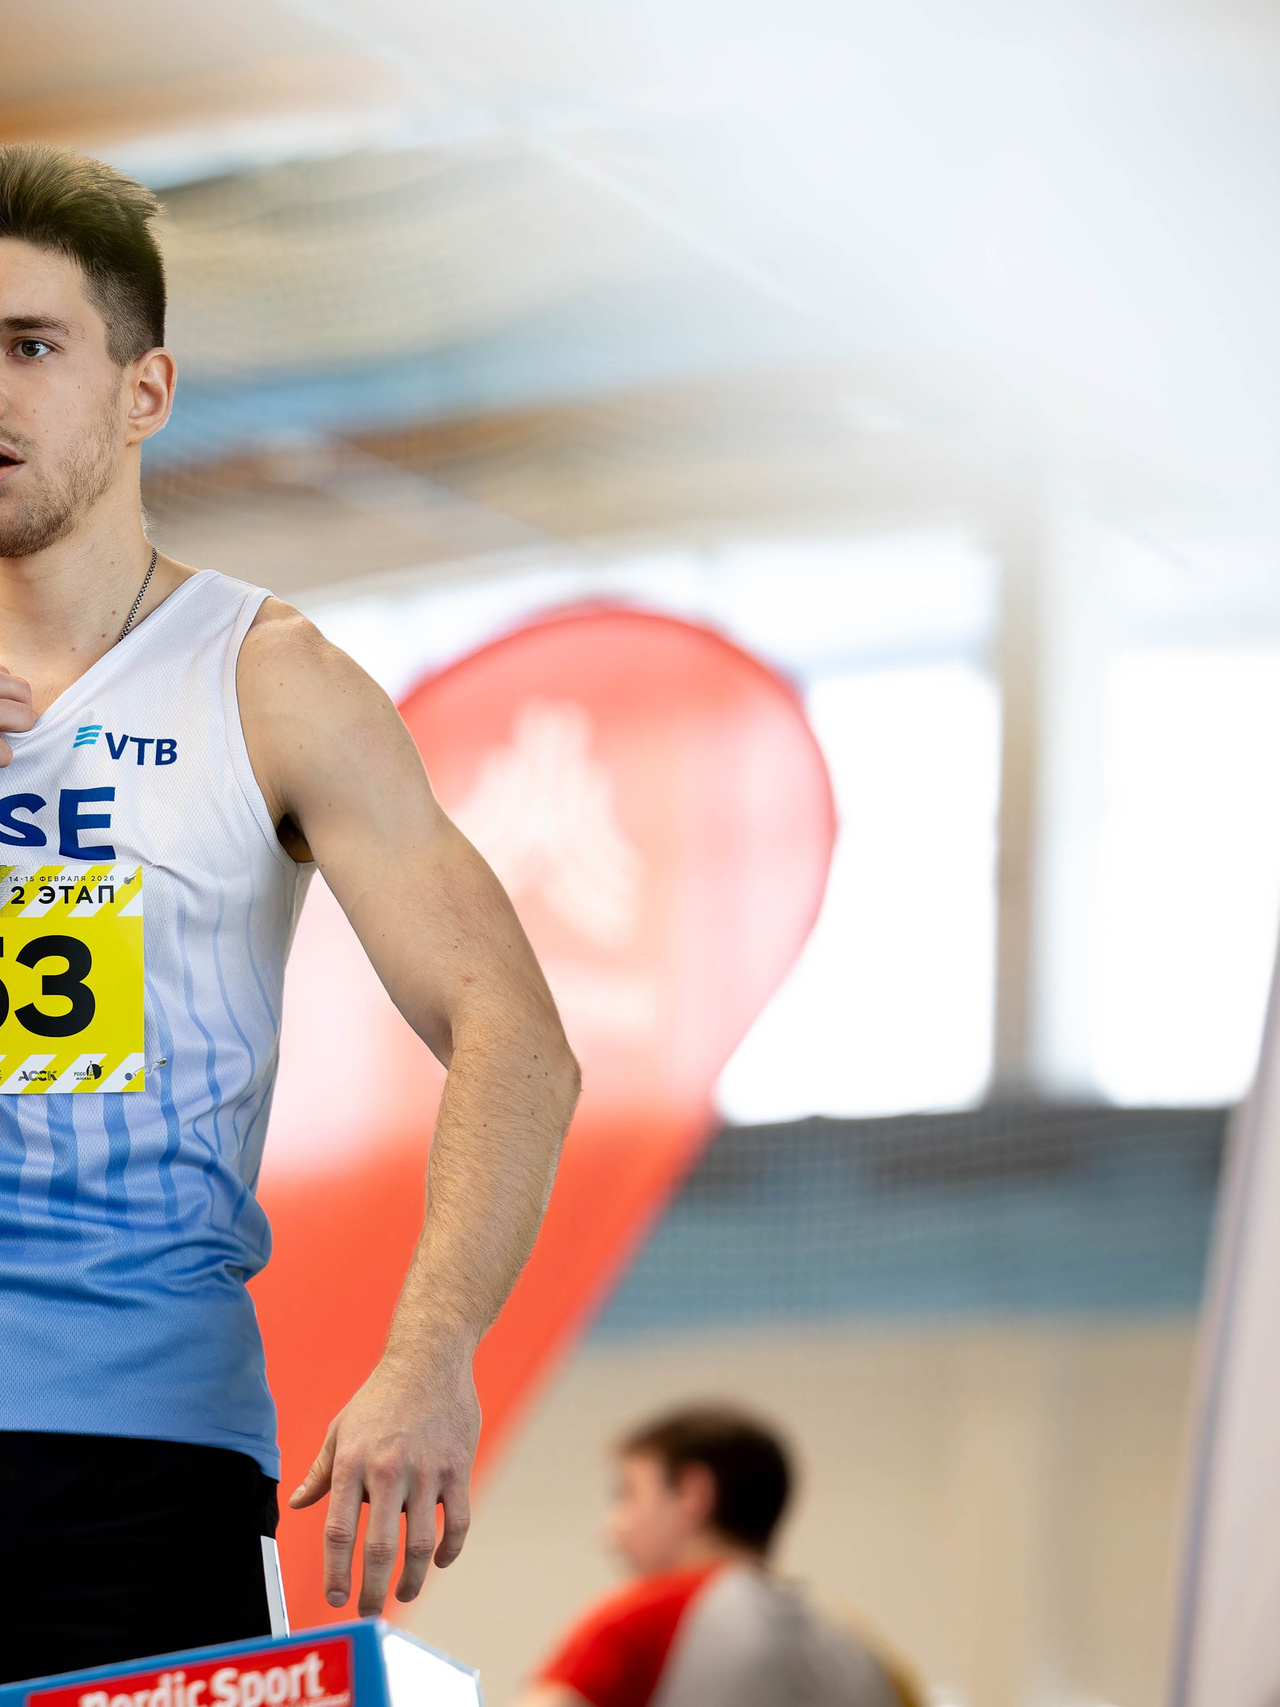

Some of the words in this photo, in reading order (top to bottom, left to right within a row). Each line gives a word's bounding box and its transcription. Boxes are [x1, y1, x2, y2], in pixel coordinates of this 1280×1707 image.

[105, 732, 178, 766] VTB
[11, 886, 25, 904] 2
[38, 885, 115, 904] ЭТАП
[209, 1650, 324, 1707] Sport
